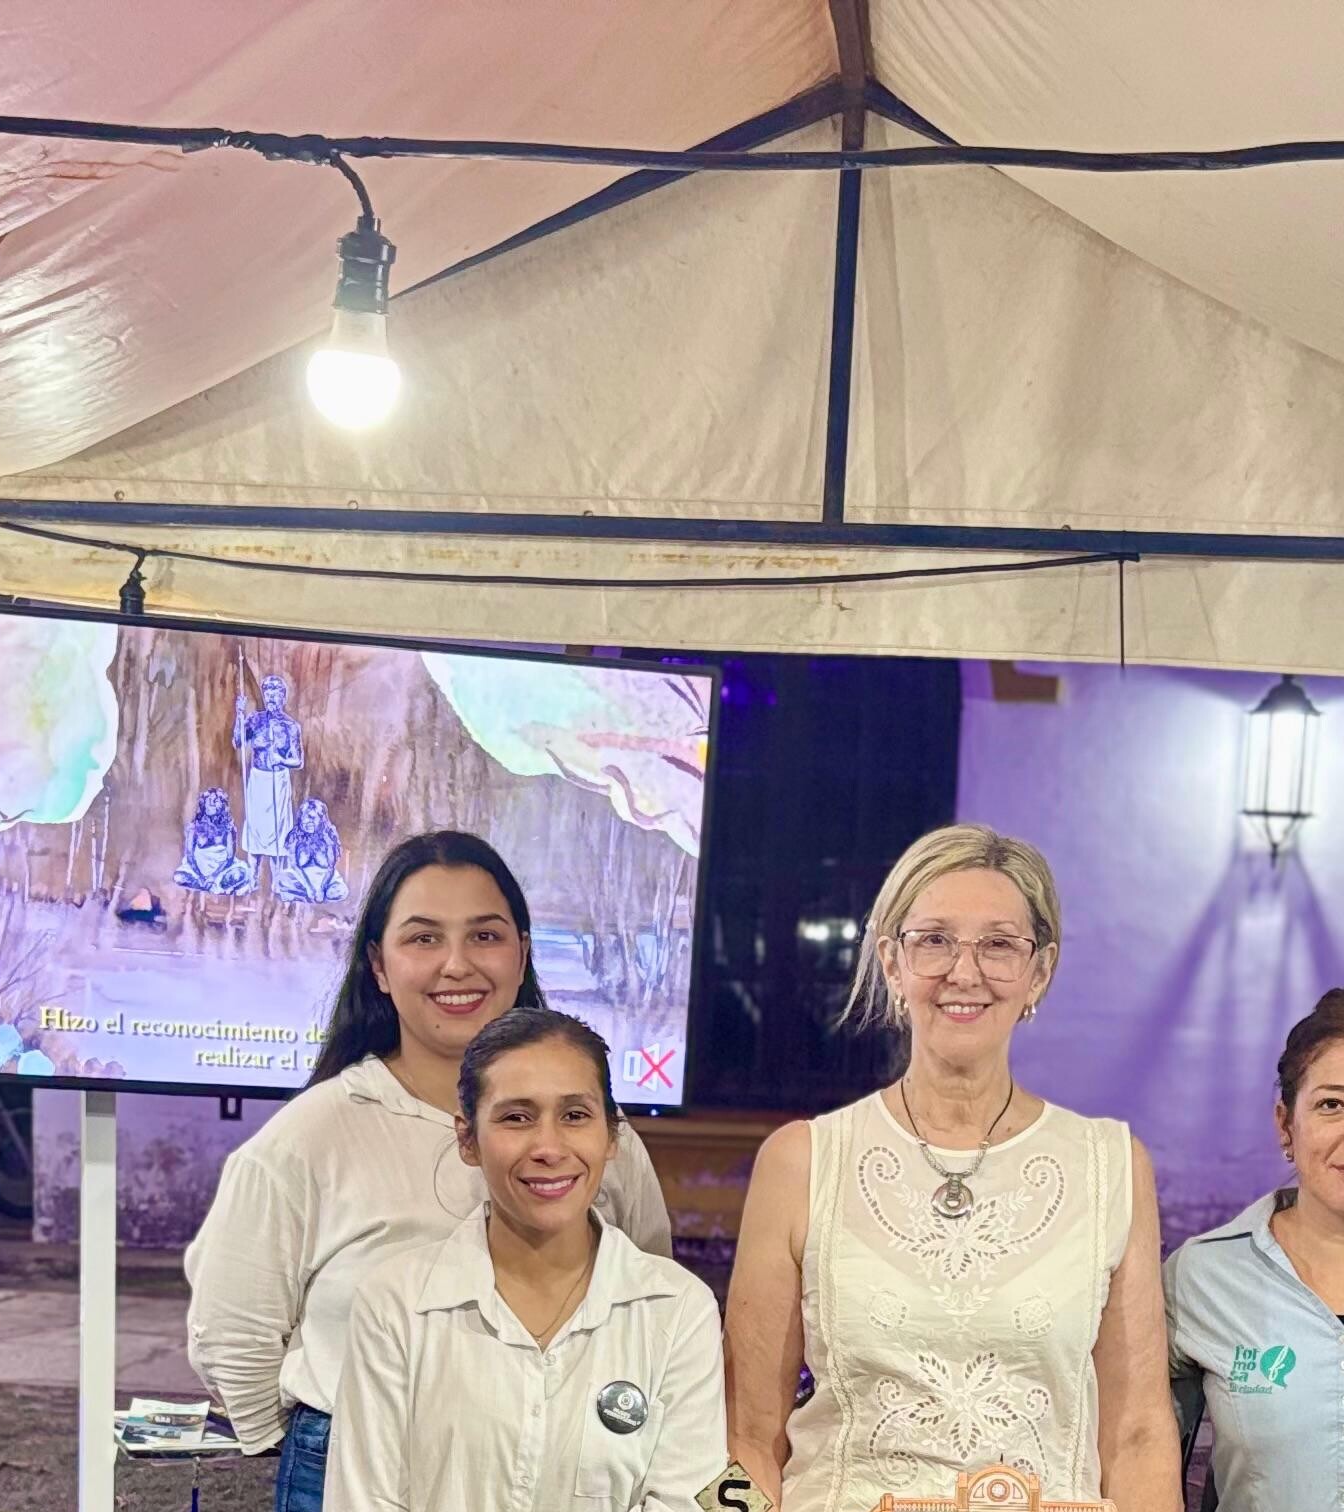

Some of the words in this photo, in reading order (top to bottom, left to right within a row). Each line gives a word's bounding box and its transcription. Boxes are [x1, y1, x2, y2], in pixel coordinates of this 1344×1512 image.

[39, 1006, 97, 1033] Hizo
[106, 1012, 124, 1034] el
[132, 1019, 298, 1044] reconocimiento
[196, 1045, 275, 1069] realizar
[281, 1048, 298, 1070] el
